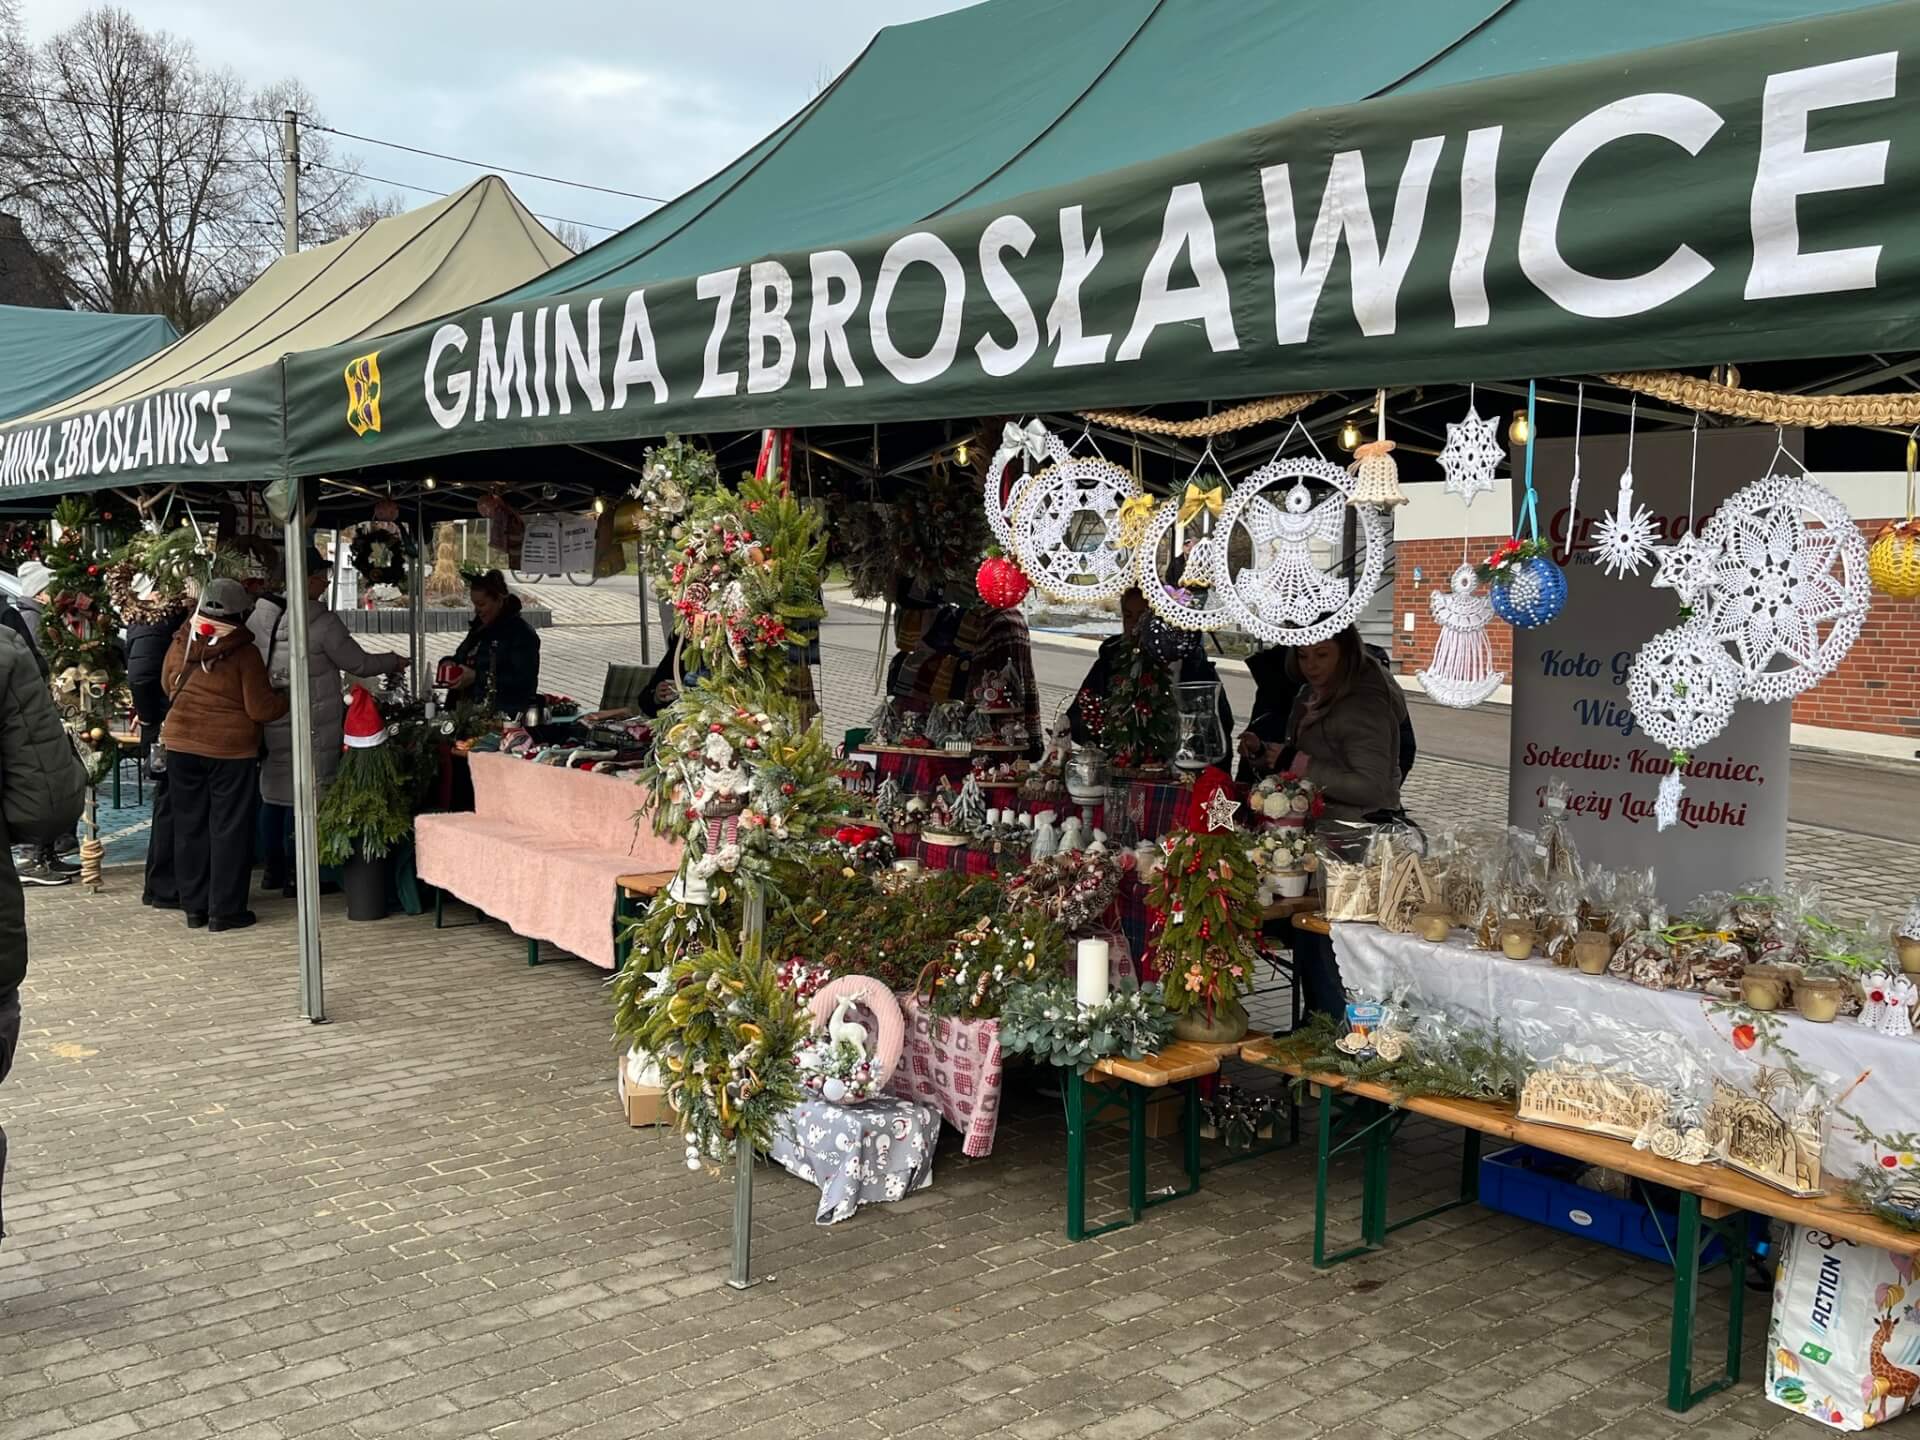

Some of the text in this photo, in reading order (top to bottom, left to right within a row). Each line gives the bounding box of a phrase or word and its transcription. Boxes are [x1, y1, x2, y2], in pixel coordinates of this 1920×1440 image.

[423, 51, 1899, 429] GMINA ZBROSŁAWICE
[53, 388, 232, 480] ZBROSŁAWICE
[1540, 649, 1603, 677] Koło
[1573, 699, 1641, 736] Wiej
[1523, 742, 1620, 771] Sołectw:
[1812, 1254, 1841, 1329] ACTION
